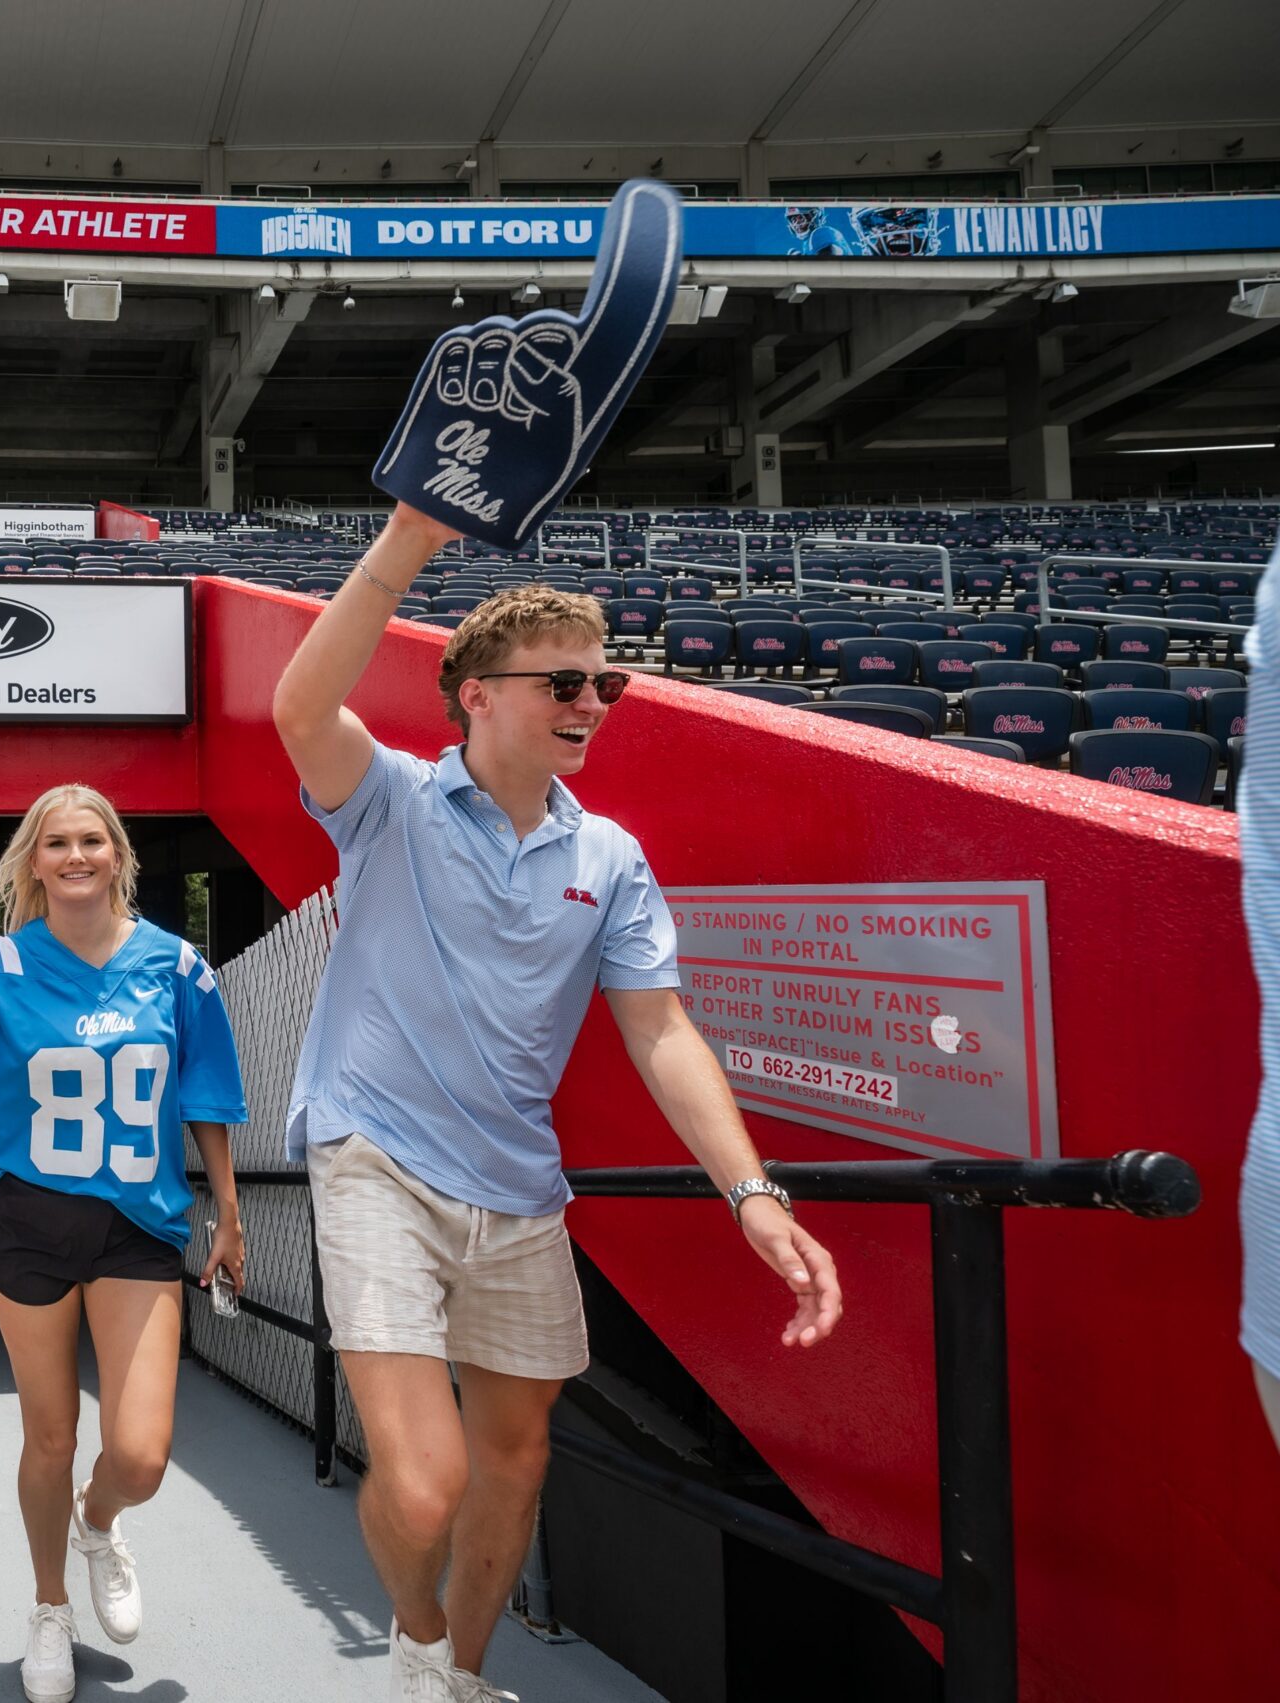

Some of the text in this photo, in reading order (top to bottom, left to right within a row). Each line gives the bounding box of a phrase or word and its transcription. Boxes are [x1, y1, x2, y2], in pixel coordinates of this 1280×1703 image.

[30, 211, 187, 240] ATHLETE
[378, 219, 592, 244] DO IT FOR U
[955, 206, 1104, 253] KEWAN LACY
[435, 420, 491, 465] Ole
[423, 458, 505, 522] Miss
[4, 521, 85, 532] Higginbotham
[7, 682, 97, 704] Dealers
[993, 715, 1045, 734] Ole Miss
[692, 912, 787, 931] STANDING
[816, 914, 849, 934] NO
[862, 915, 992, 939] SMOKING
[743, 938, 859, 962] IN PORTAL
[692, 973, 941, 1017] REPORT UNRULY FANS
[75, 1012, 136, 1036] Ole Miss
[702, 997, 763, 1021] OTHER
[773, 1006, 873, 1038] STADIUM
[885, 1020, 982, 1053] ISSS
[871, 1051, 887, 1069] &
[729, 1050, 893, 1101] TO 662-291-7242
[27, 1044, 170, 1183] 89
[758, 1077, 784, 1090] TEXT
[788, 1084, 838, 1103] MESSAGE
[841, 1096, 879, 1113] RATES
[886, 1107, 926, 1123] APPLY
